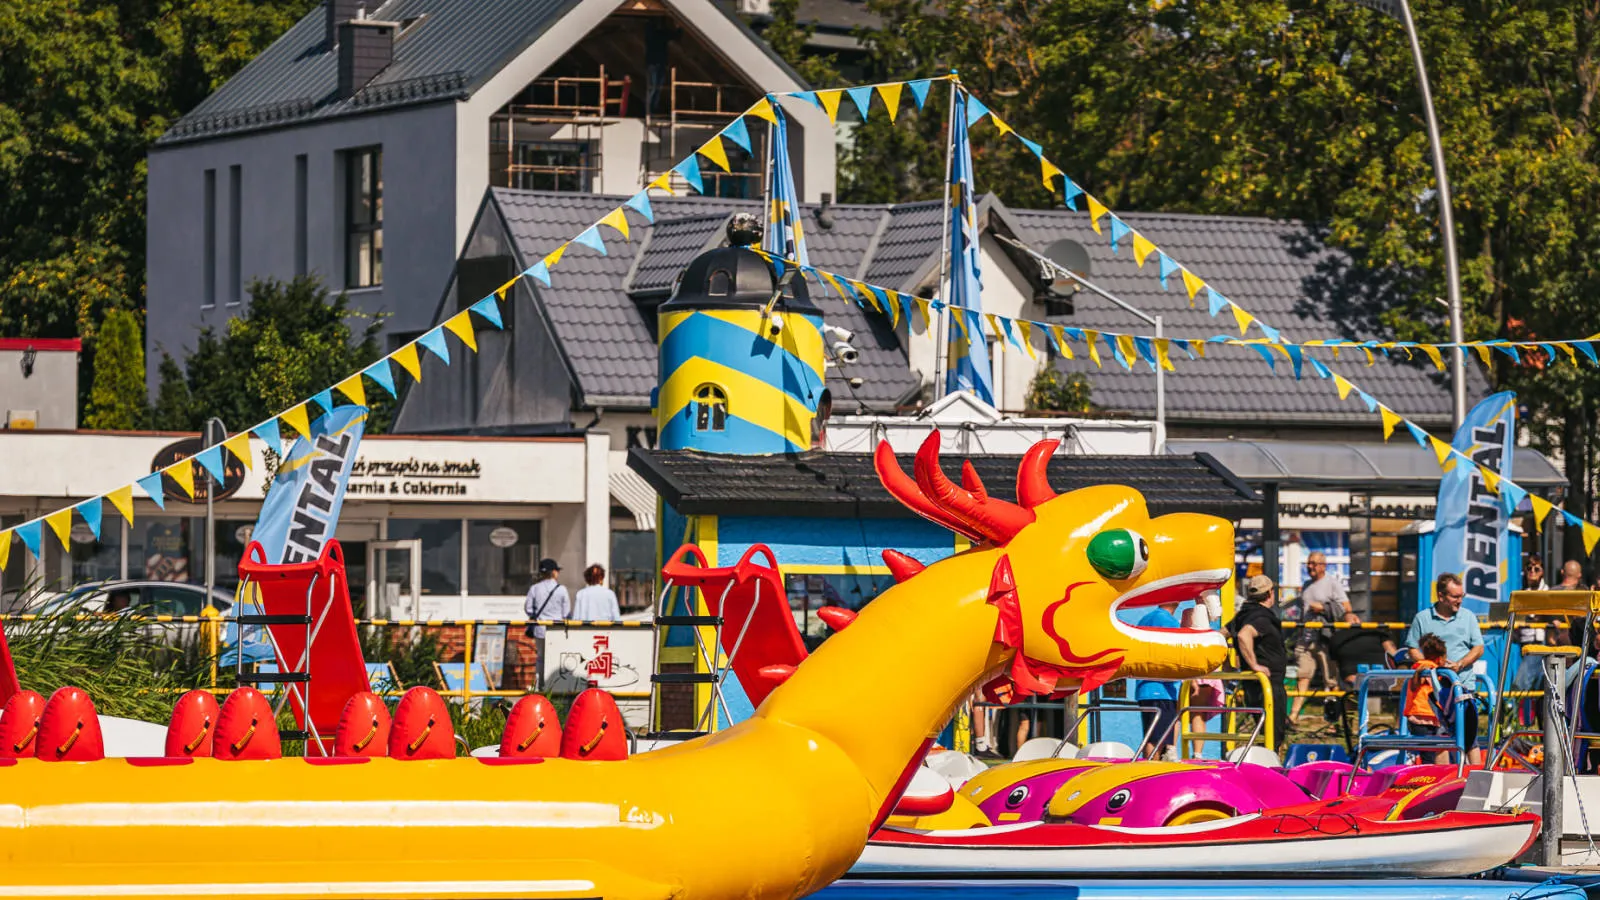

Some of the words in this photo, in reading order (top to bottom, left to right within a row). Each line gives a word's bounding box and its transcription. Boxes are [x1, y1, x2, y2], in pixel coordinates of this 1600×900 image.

[421, 460, 439, 472] na
[441, 458, 480, 472] smak
[390, 481, 399, 494] &
[403, 481, 467, 495] Cukiernia
[1465, 419, 1507, 601] RENTAL
